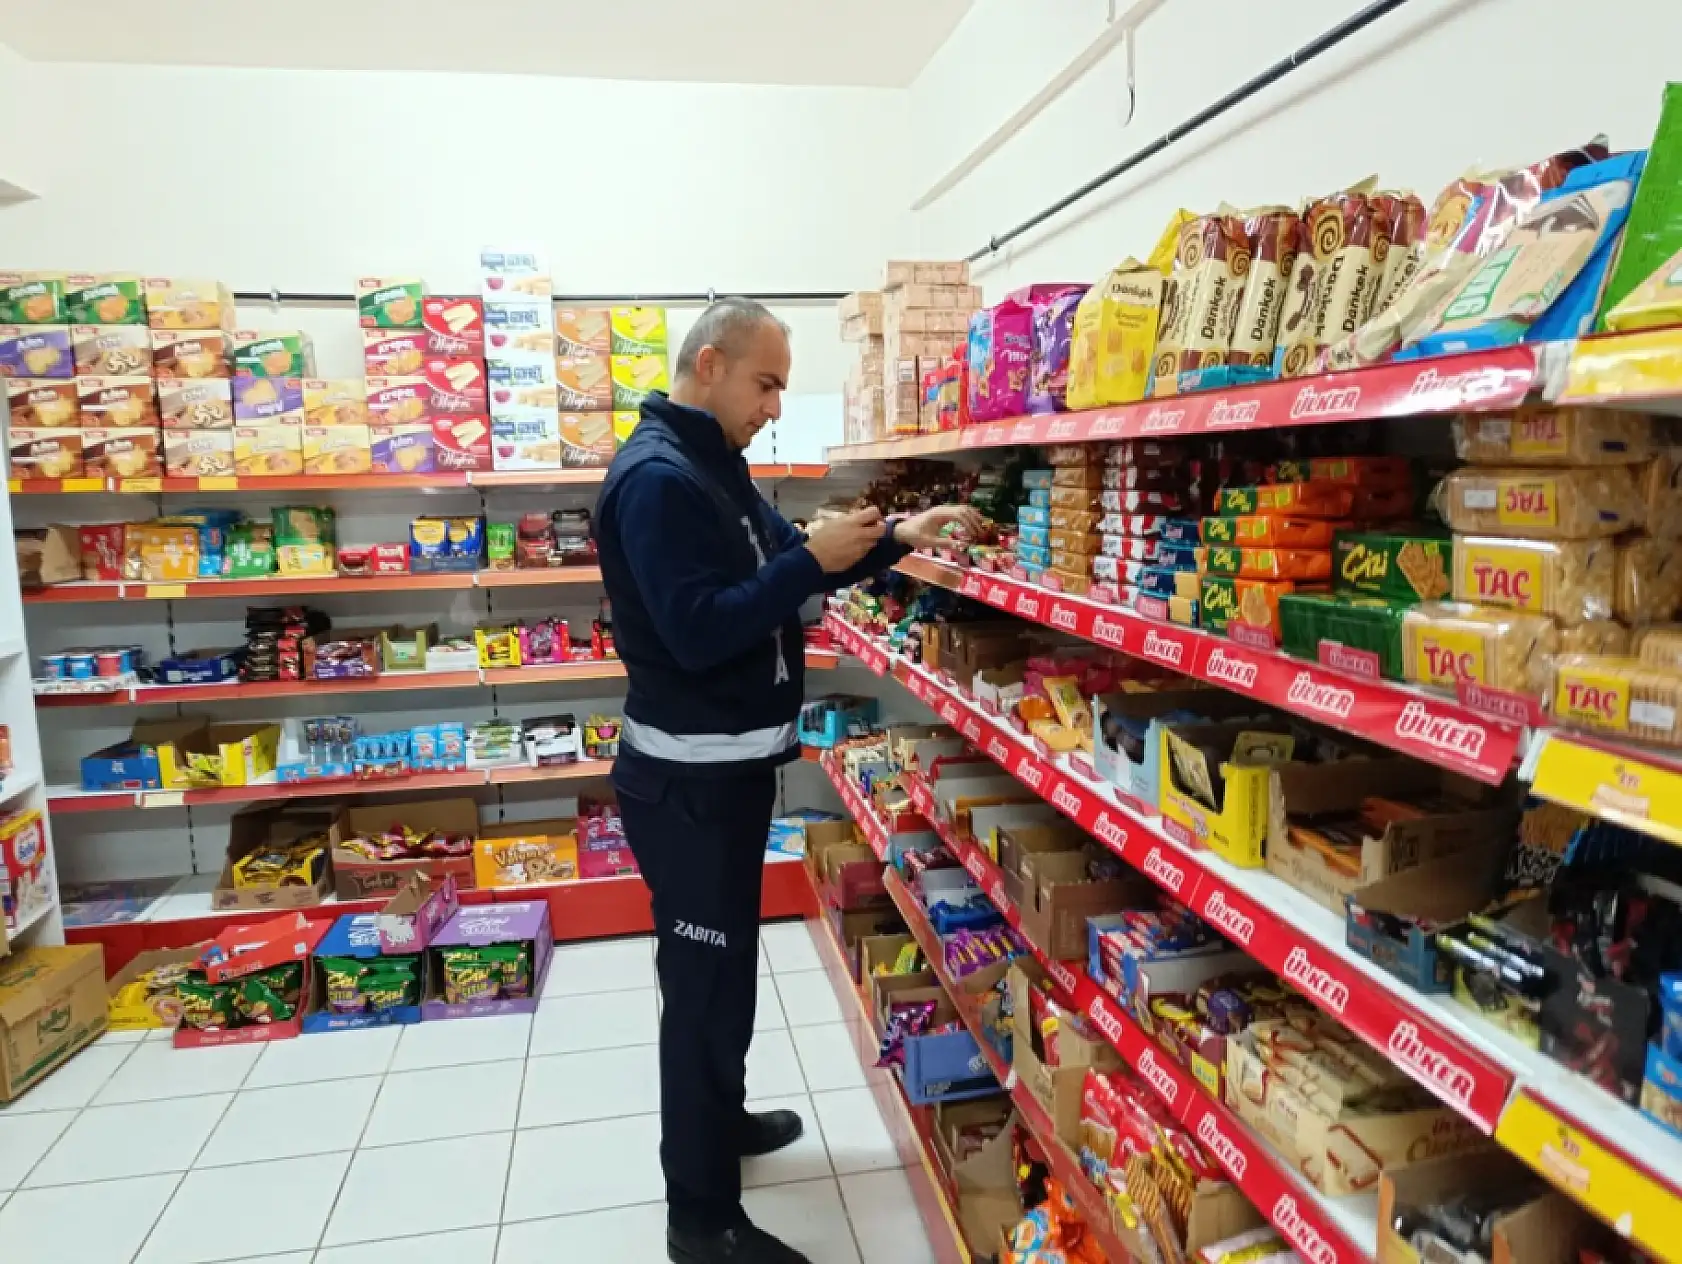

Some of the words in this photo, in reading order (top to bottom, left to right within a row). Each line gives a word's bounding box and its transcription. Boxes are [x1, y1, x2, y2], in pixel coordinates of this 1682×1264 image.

[1200, 275, 1228, 340] Dankek
[1250, 276, 1276, 342] Dankek
[1342, 263, 1370, 333] Dankek
[1207, 400, 1260, 428] ÜLKER
[1290, 384, 1360, 418] ÜLKER
[1092, 614, 1125, 645] ÜLKER
[1143, 630, 1184, 666] ÜLKER
[1206, 648, 1258, 688] ÜLKER
[1287, 671, 1355, 718] ÜLKER
[1395, 701, 1487, 760] ÜLKER
[1093, 811, 1129, 852] ÜLKER
[1144, 846, 1185, 893] ÜLKER
[673, 918, 727, 949] ZABITA
[1204, 890, 1255, 945] ÜLKER
[1284, 946, 1350, 1014] ÜLKER
[1088, 995, 1123, 1043] ÜLKER
[1137, 1047, 1178, 1104] ÜLKER
[1388, 1019, 1475, 1106] ÜLKER
[1197, 1111, 1248, 1181] ÜLKER
